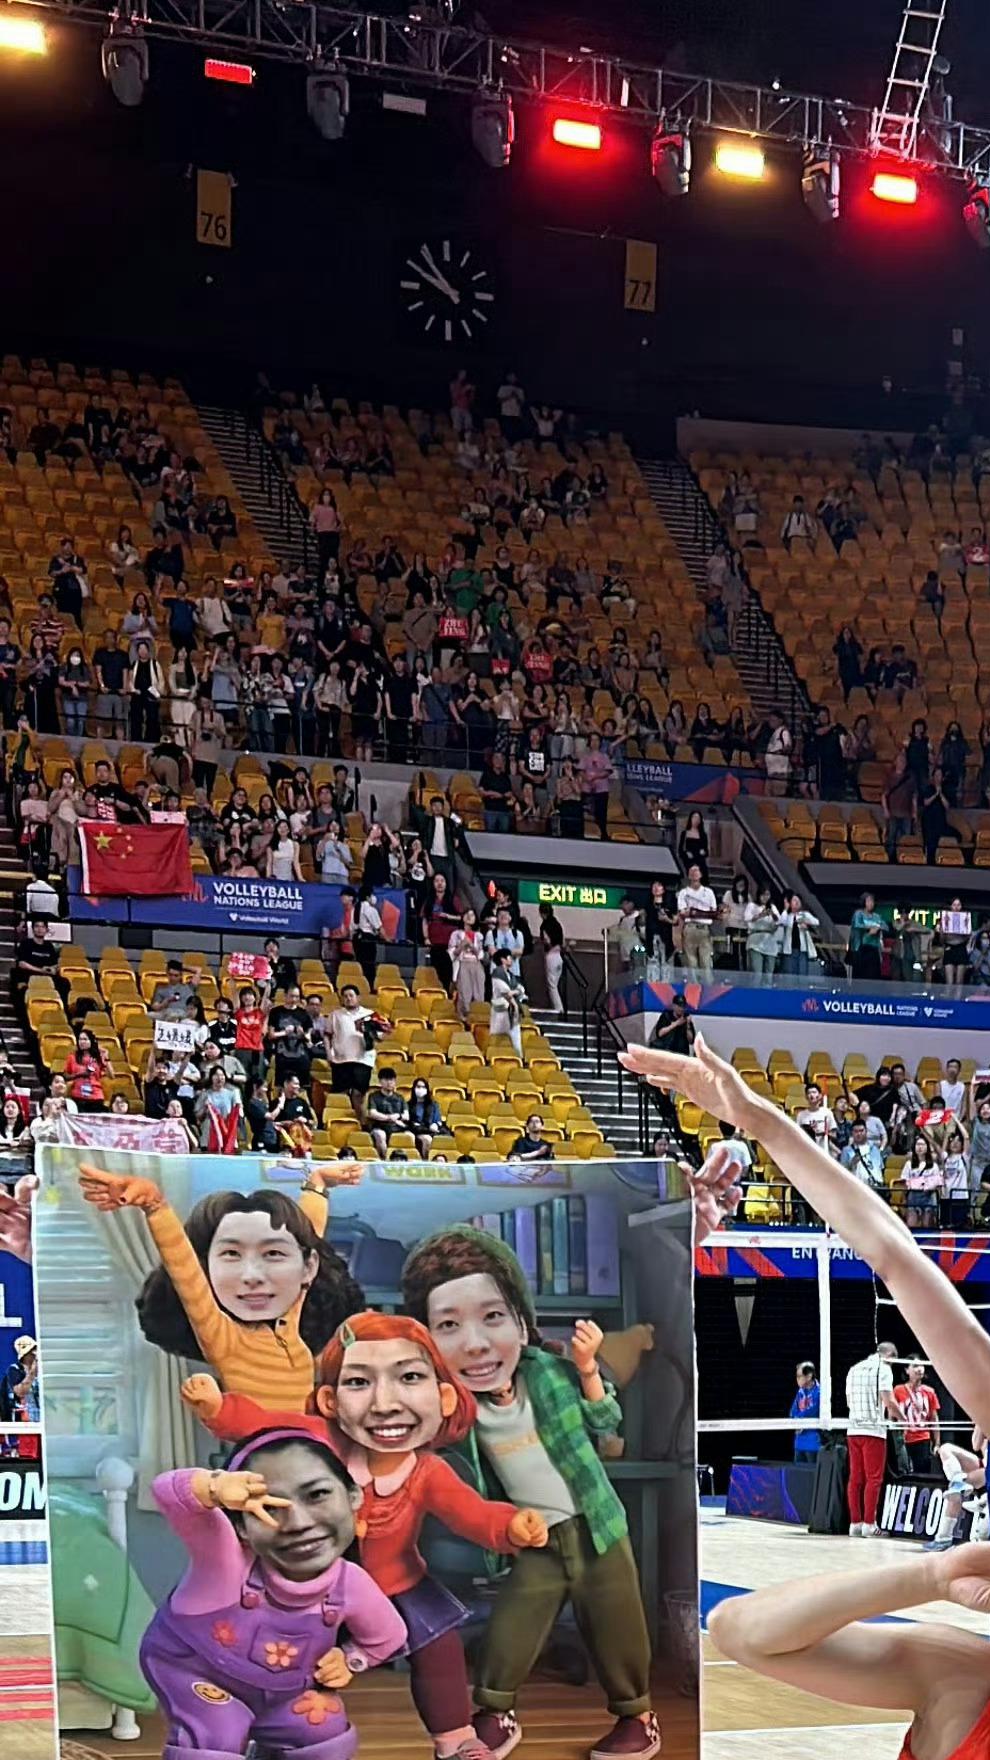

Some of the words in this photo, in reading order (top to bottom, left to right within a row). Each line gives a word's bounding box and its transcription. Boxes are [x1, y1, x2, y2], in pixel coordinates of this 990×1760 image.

[201, 211, 227, 240] 76
[629, 279, 651, 304] 77
[213, 882, 303, 900] VOLLEYBALL
[539, 883, 576, 902] EXIT
[580, 887, 607, 904] 出口
[213, 896, 260, 907] NATIONS
[263, 899, 303, 911] LEAGUE
[823, 1001, 896, 1015] VOLLEYBALL
[881, 1483, 967, 1539] WELCO
